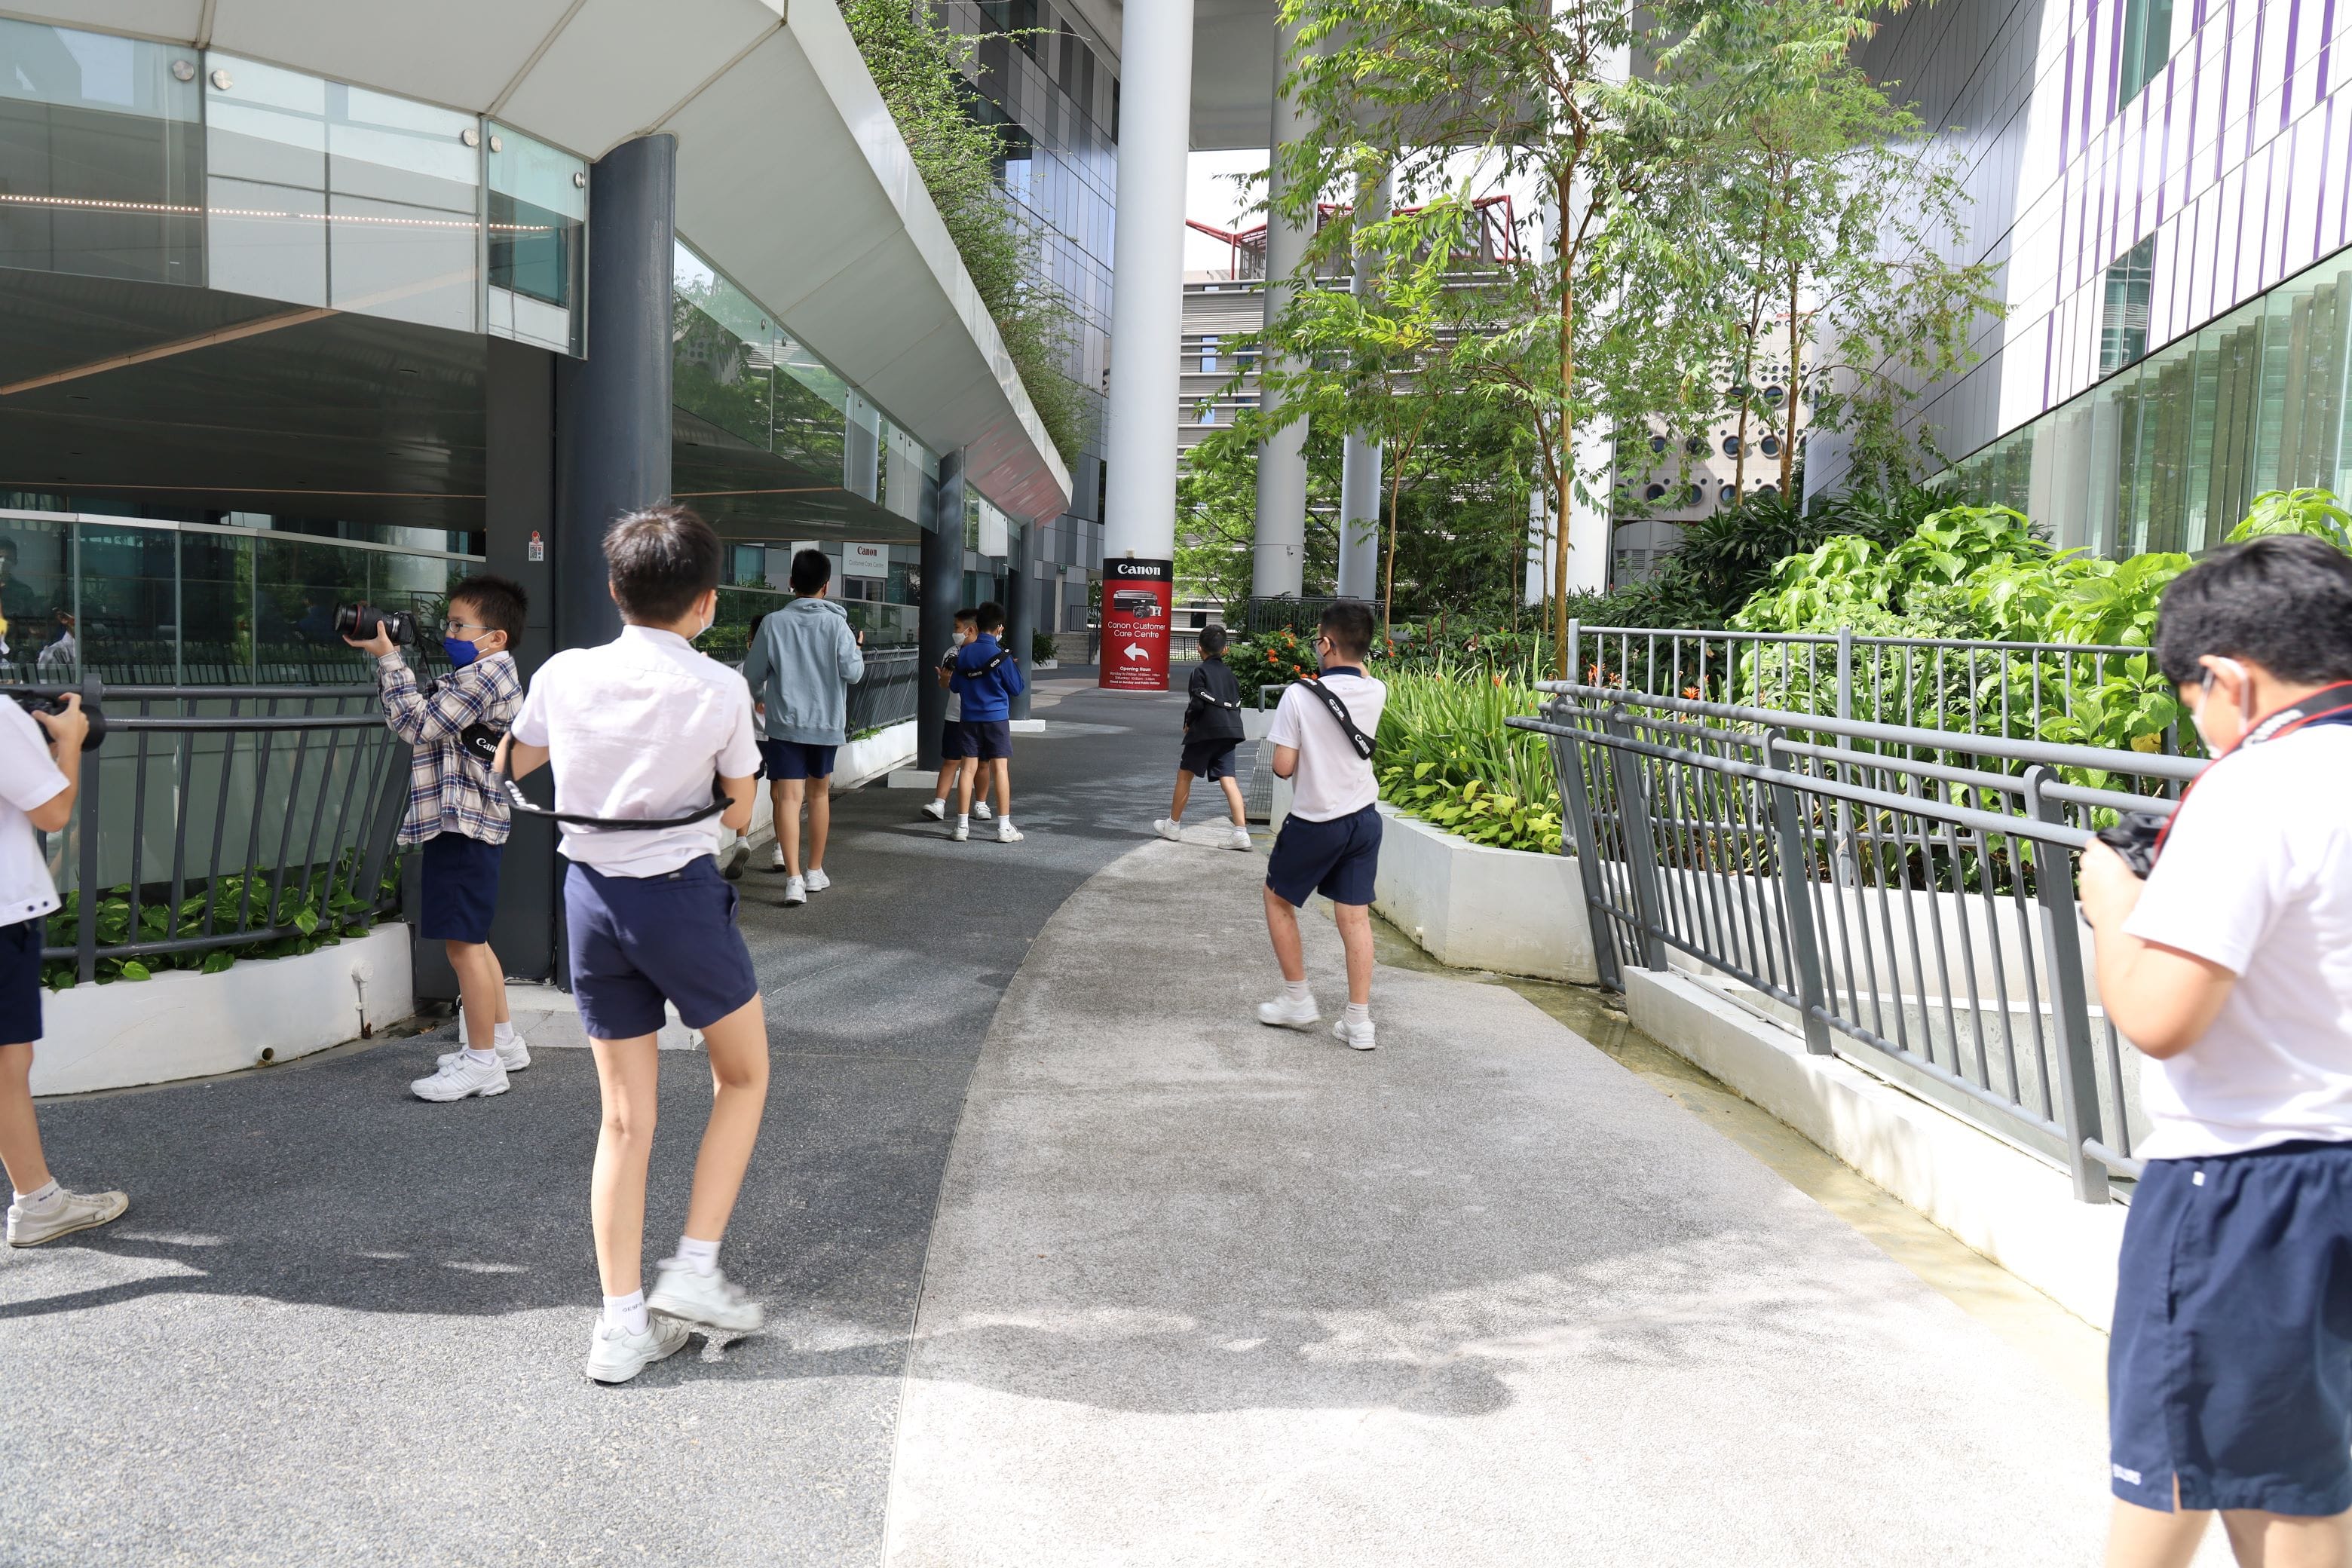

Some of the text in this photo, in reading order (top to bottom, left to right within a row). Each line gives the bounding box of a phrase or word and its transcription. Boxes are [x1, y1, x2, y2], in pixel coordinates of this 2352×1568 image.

[857, 546, 877, 556] Canon
[1117, 564, 1161, 575] Canon
[1133, 622, 1165, 630] Customer
[1134, 630, 1159, 639] Centre
[476, 737, 498, 753] Can
